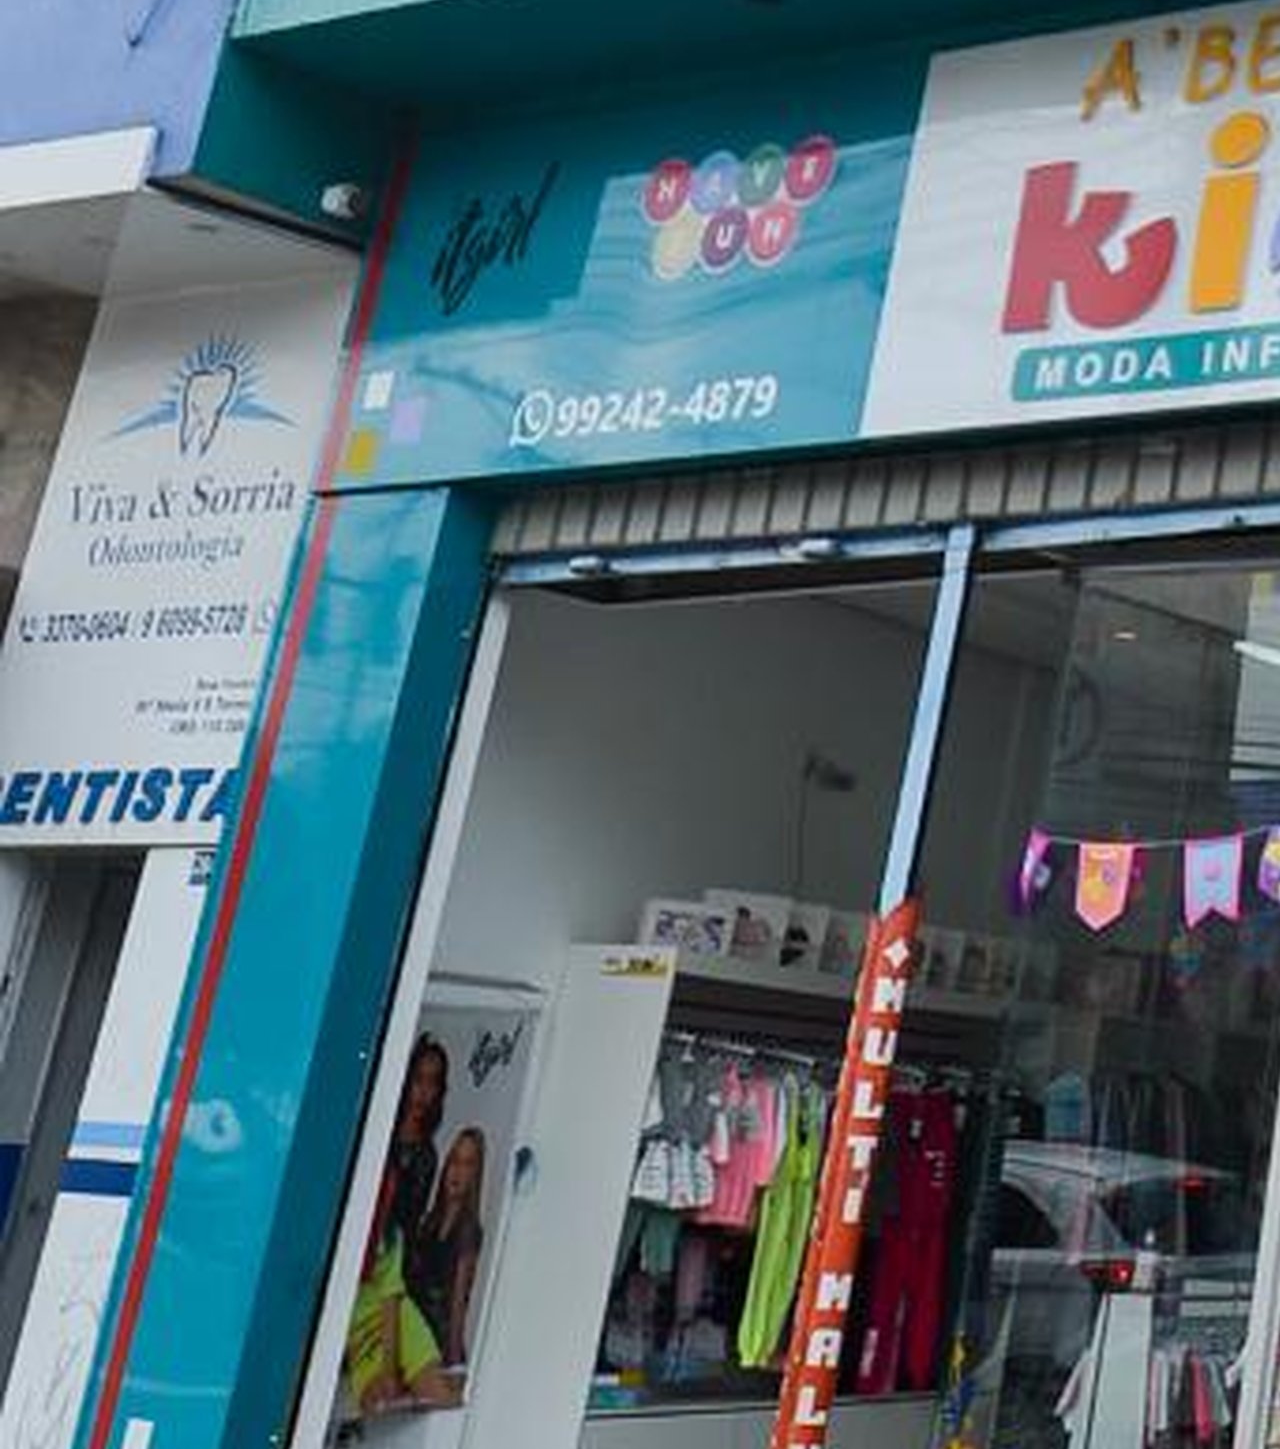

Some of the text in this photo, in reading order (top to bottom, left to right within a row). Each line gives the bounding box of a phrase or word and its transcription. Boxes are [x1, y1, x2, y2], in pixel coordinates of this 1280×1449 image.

[1035, 345, 1174, 389] MODA
[557, 375, 778, 438] 99242-4879
[70, 483, 139, 524] Viva
[186, 466, 296, 517] Sorria
